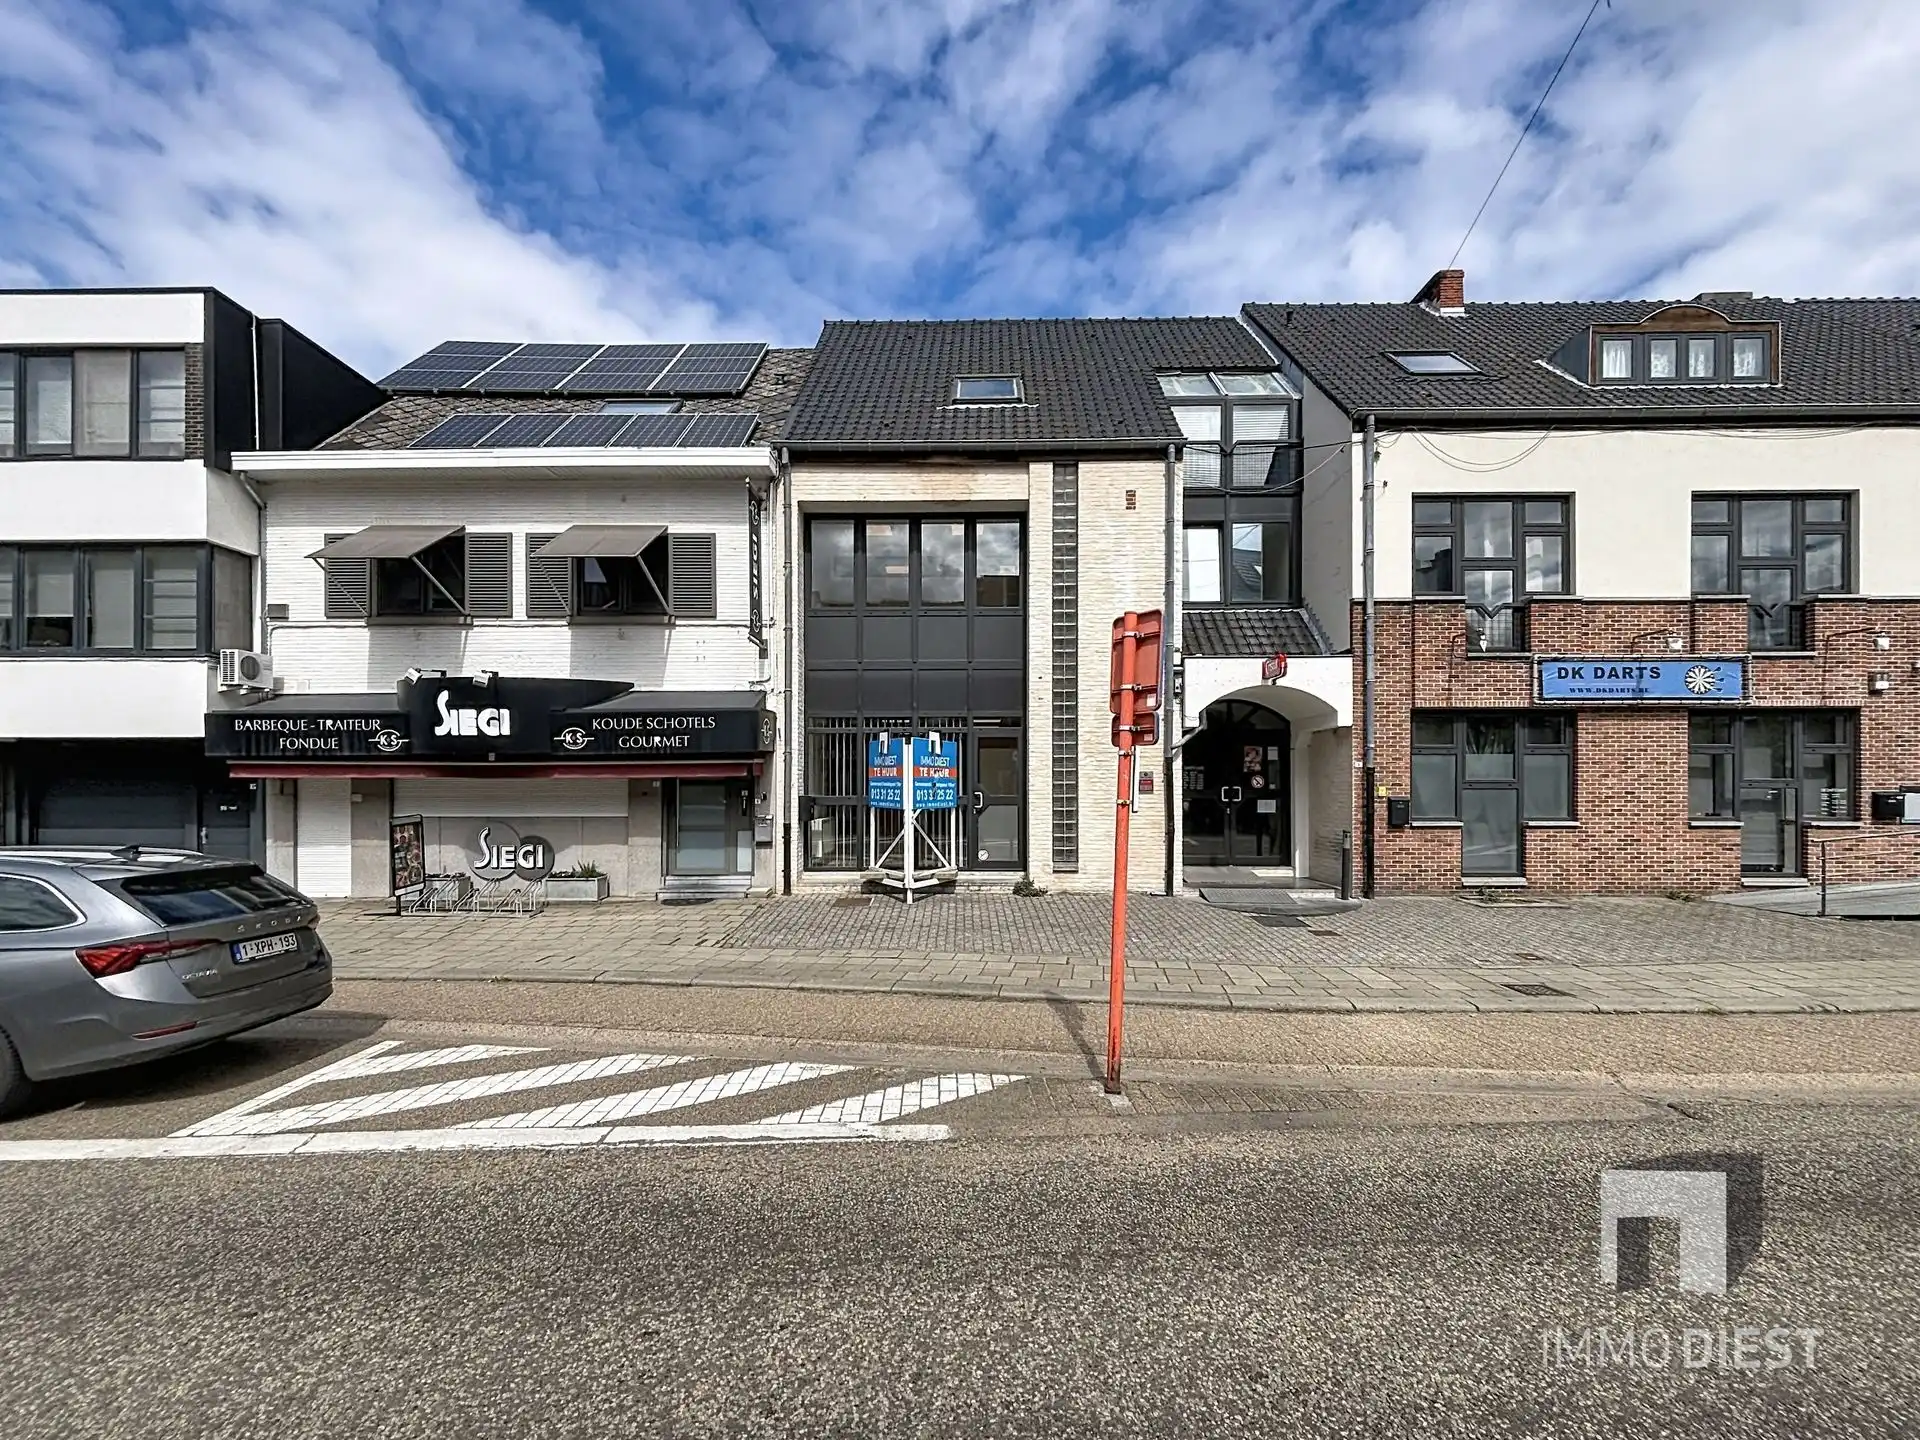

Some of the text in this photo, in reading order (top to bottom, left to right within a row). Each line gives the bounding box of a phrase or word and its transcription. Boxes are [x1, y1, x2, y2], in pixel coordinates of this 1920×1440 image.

[1557, 666, 1662, 680] DK DARTS
[434, 689, 511, 737] SIEGI
[592, 716, 716, 730] KOUDE SCHOTELS
[279, 737, 339, 750] FONDUE
[619, 735, 690, 748] GOURMET
[874, 768, 898, 777] TE HUUR
[919, 767, 928, 777] TE
[871, 788, 880, 800] 013
[916, 789, 928, 801] 013
[937, 789, 945, 800] 25
[946, 789, 954, 800] 22
[474, 826, 545, 869] SIEGI
[242, 934, 296, 956] 1-XPH-193
